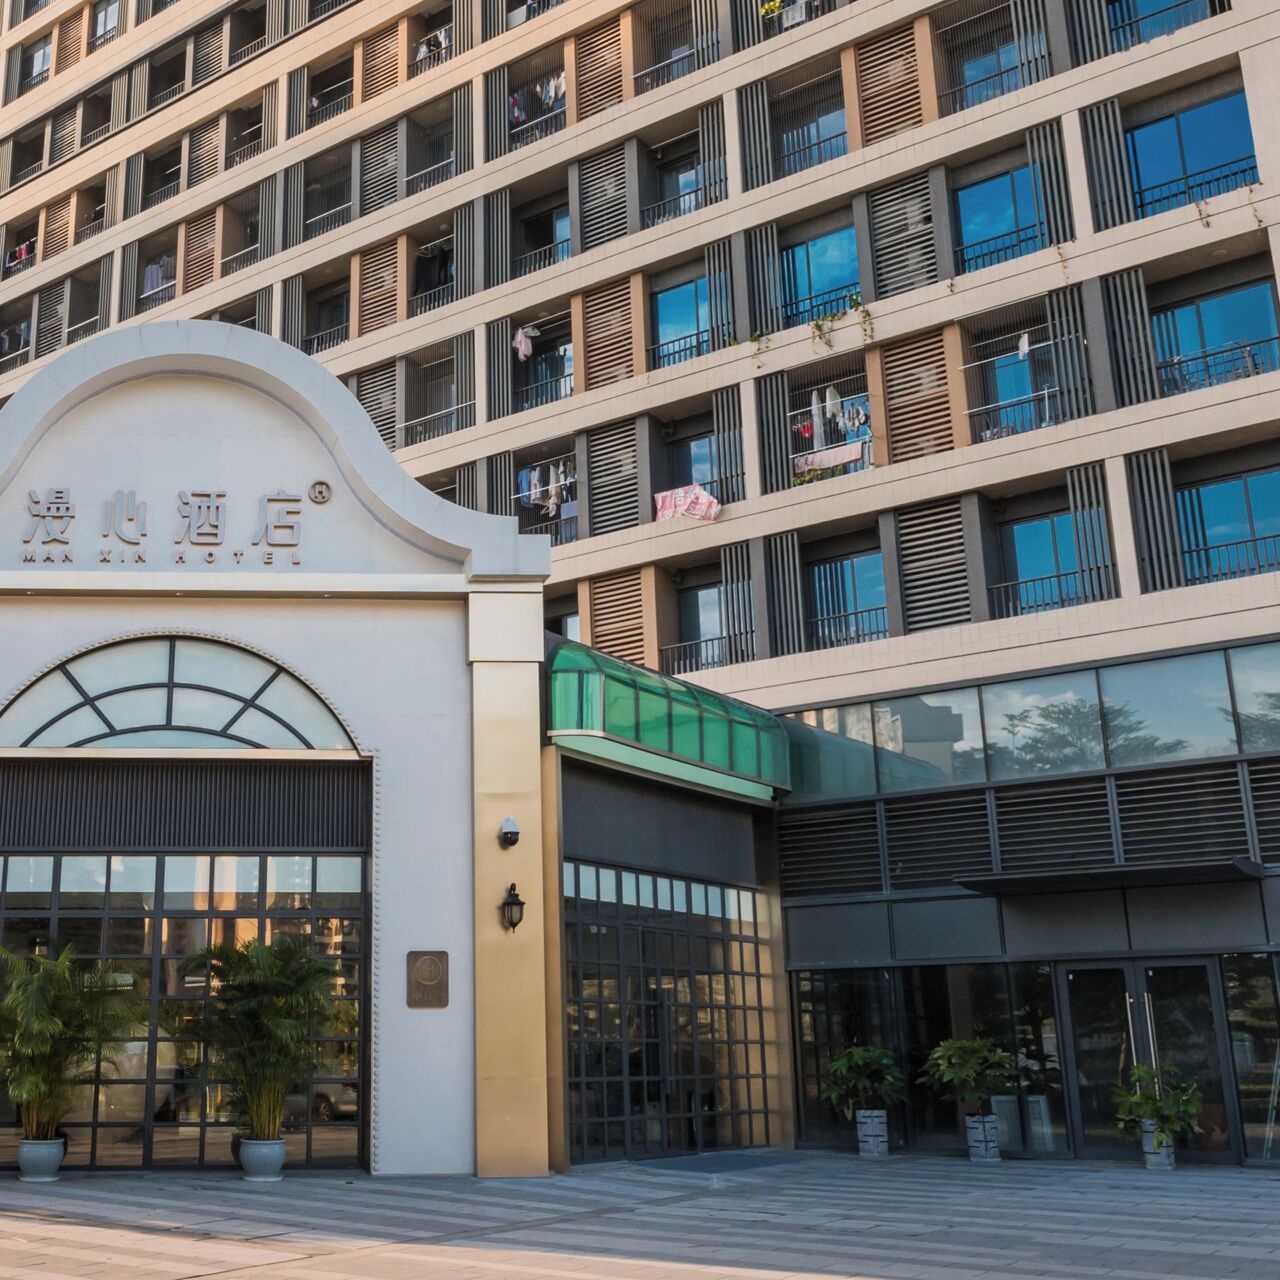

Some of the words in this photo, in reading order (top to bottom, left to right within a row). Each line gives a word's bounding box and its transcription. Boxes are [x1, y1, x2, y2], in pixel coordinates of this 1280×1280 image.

[22, 487, 302, 547] 漫心酒店
[22, 549, 73, 563] MAN
[99, 549, 147, 564] XIN
[175, 550, 301, 565] HOTEL
